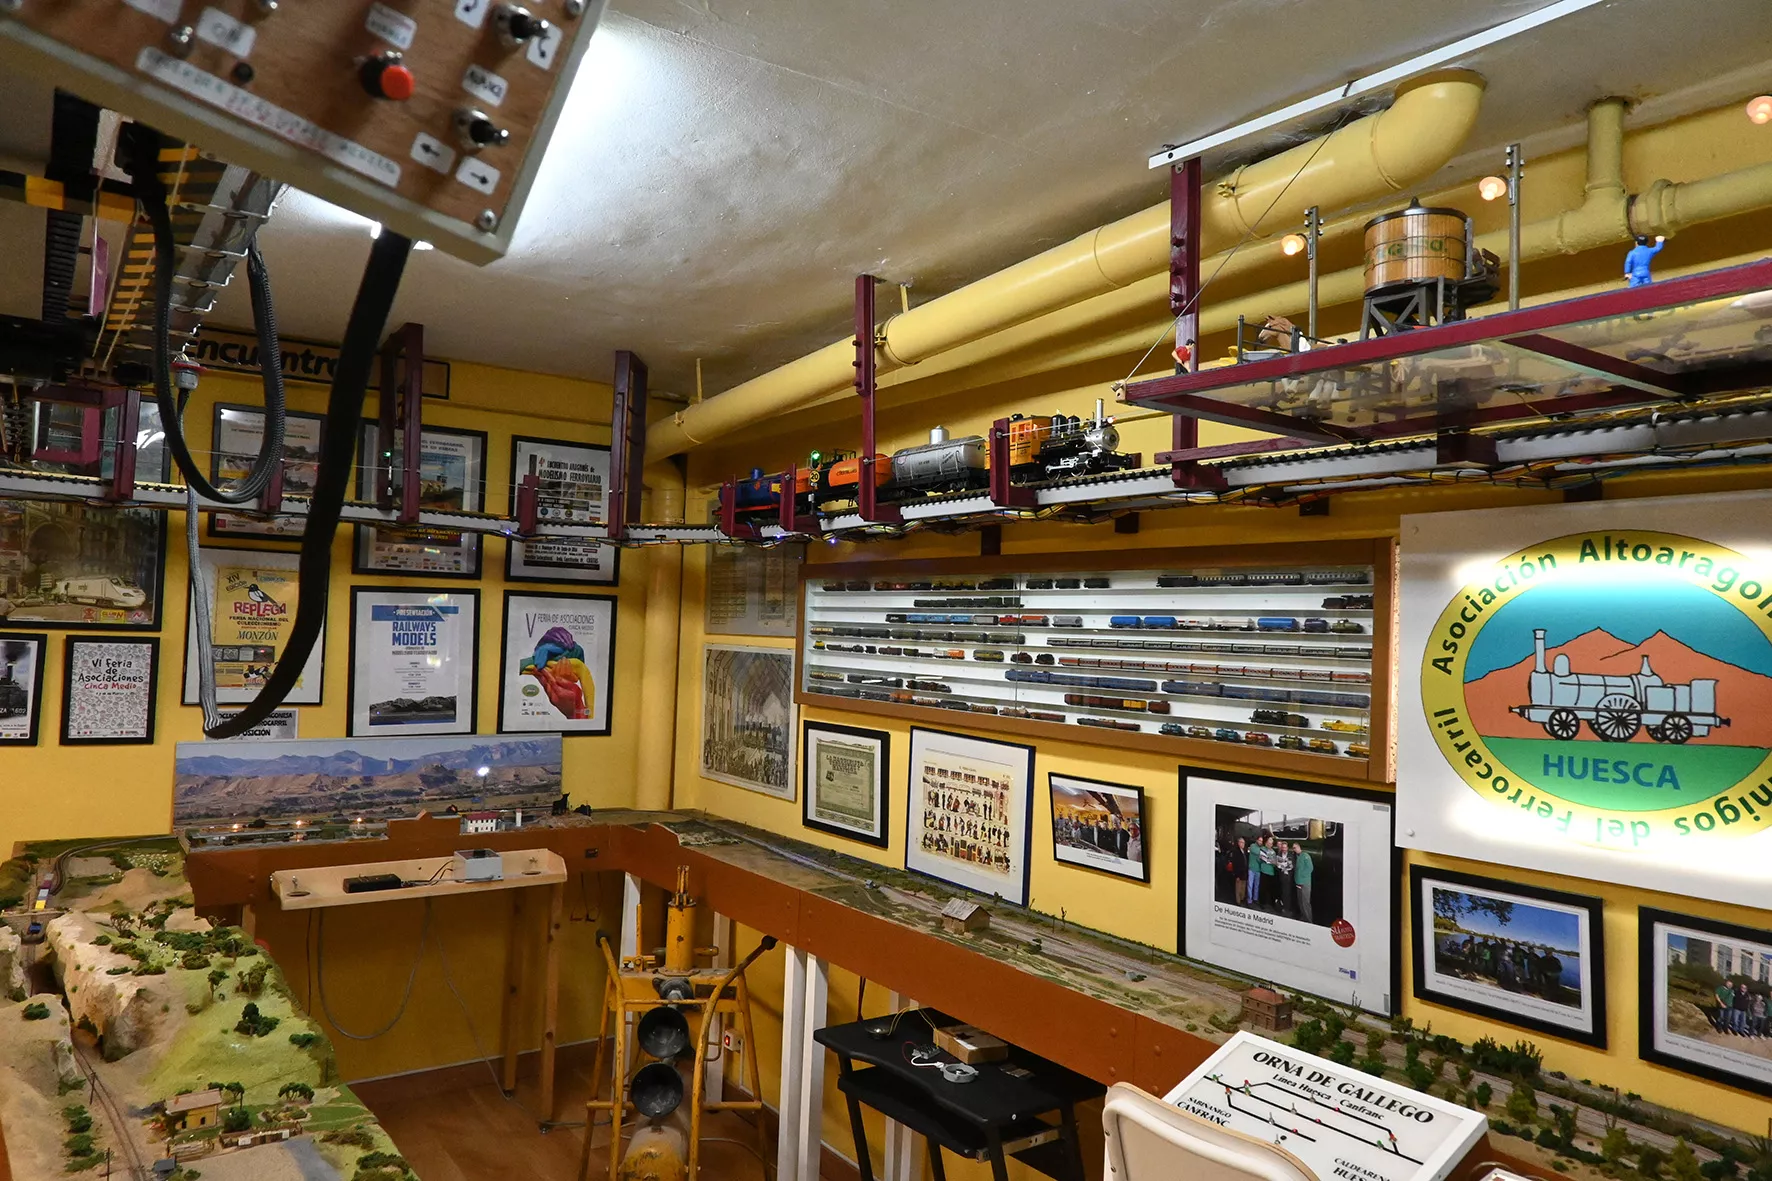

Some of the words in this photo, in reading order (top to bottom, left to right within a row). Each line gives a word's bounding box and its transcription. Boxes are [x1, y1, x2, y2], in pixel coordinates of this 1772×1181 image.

[810, 472, 820, 480] 20
[226, 573, 240, 584] XIV
[233, 601, 287, 617] REPLEGA
[1432, 552, 1557, 676] Asociación
[392, 621, 436, 632] RAILWAYS
[526, 613, 537, 638] V
[236, 629, 279, 641] MONZÓN
[392, 633, 437, 646] MODELS
[92, 658, 102, 668] VI
[106, 658, 133, 668] Feria
[105, 667, 118, 675] de
[78, 673, 144, 682] Asociaciones
[1434, 707, 1573, 835] Ferrocarril
[1542, 753, 1682, 791] HUESCA
[1597, 817, 1650, 847] del
[1214, 905, 1224, 913] De
[1224, 907, 1246, 919] Huesca
[1253, 914, 1274, 925] Madrid
[1252, 1050, 1304, 1078] ORNA
[1306, 1070, 1335, 1088] DE
[1337, 1082, 1435, 1124] GALLEGO
[1299, 1083, 1332, 1101] Huesca
[1339, 1099, 1384, 1121] Canfranc
[1177, 1101, 1231, 1128] CANFRANC
